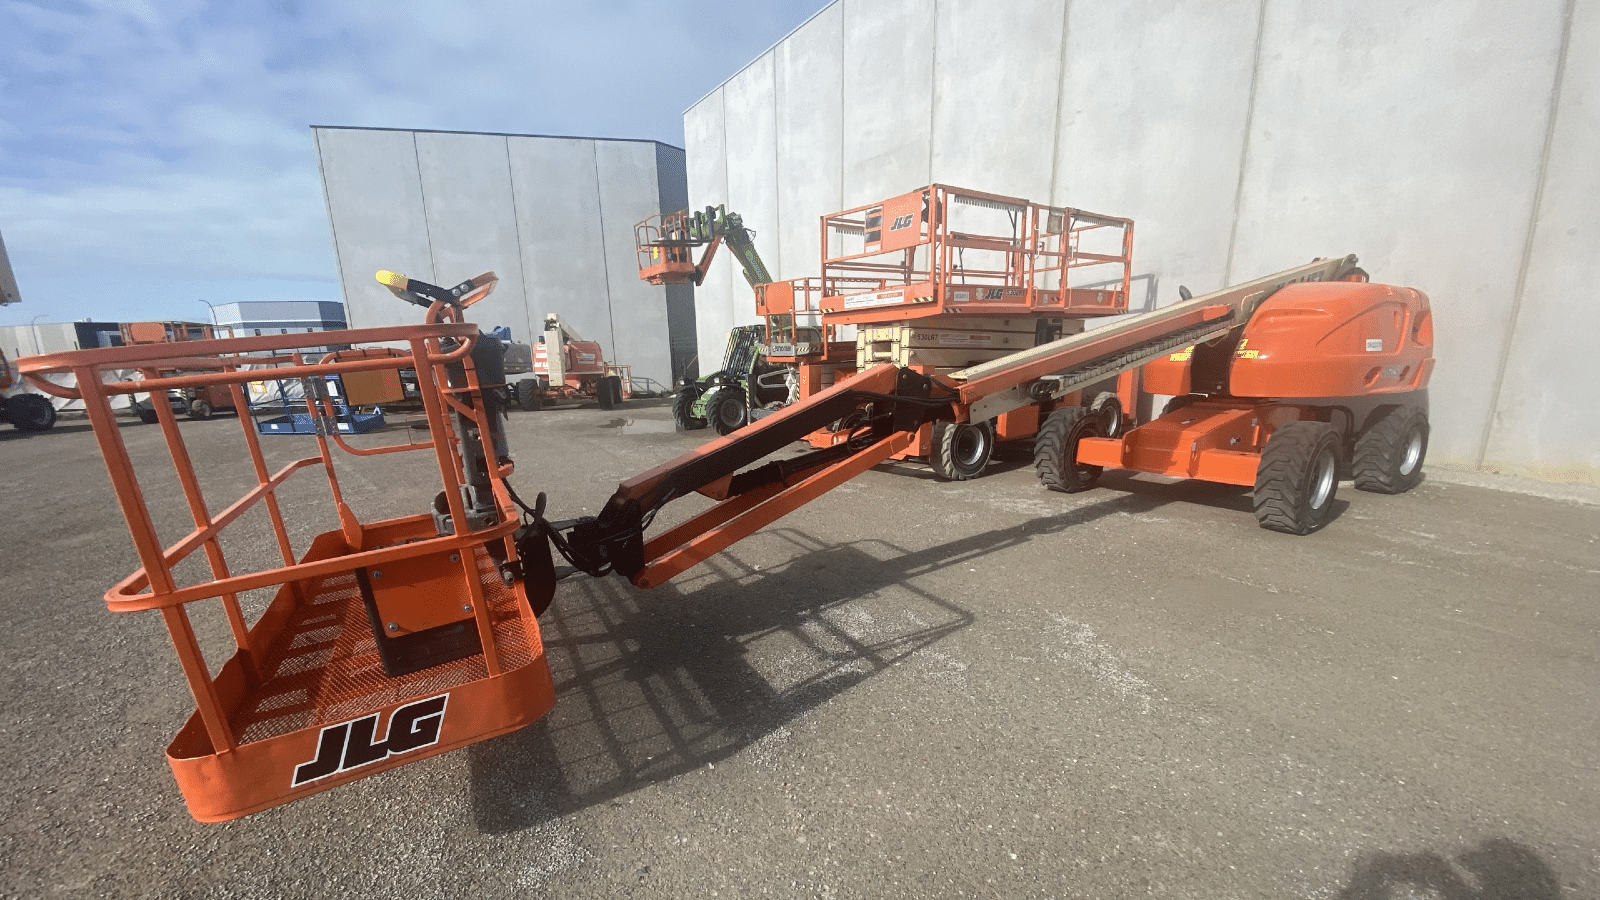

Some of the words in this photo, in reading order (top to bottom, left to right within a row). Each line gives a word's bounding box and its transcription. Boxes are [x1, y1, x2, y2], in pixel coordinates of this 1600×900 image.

[889, 213, 914, 232] JLG
[984, 288, 1004, 300] JLG
[291, 692, 450, 788] JLG
